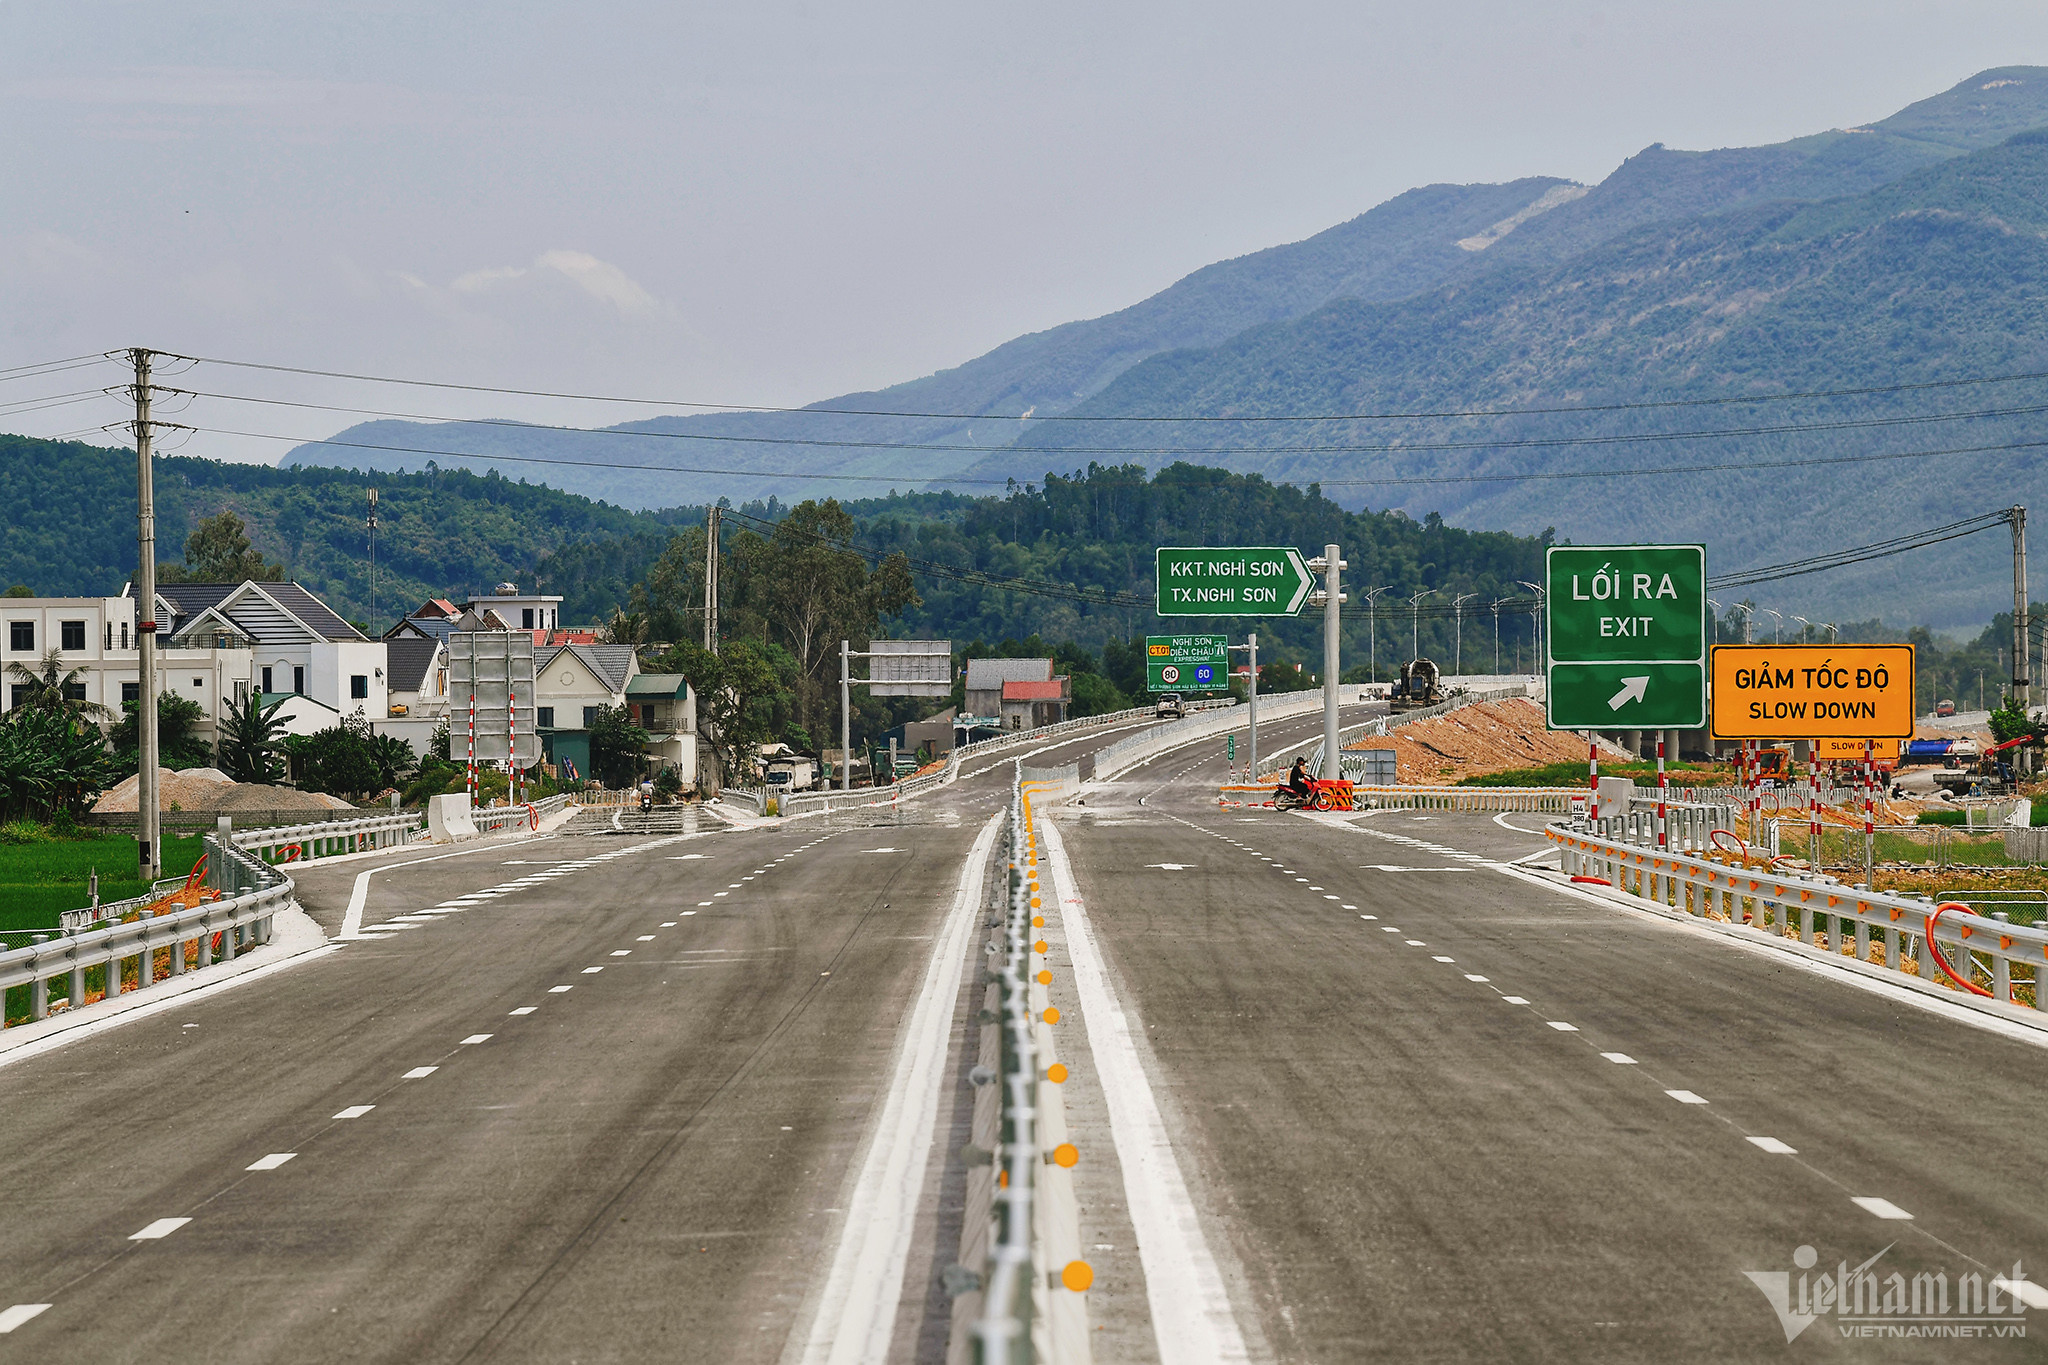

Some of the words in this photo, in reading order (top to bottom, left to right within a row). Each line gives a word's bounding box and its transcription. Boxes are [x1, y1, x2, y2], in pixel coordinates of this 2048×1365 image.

[1250, 560, 1284, 577] SƠN
[1572, 562, 1620, 601] LỐI
[1633, 573, 1678, 600] RA
[1171, 588, 1235, 603] TX.NGHI
[1242, 587, 1276, 603] SƠN
[1600, 617, 1653, 637] EXIT
[1172, 638, 1193, 647] NGHI
[1191, 646, 1214, 656] CHÂU
[1164, 670, 1177, 680] 80
[1198, 669, 1210, 679] 60
[1735, 661, 1794, 689] GIẢM
[1802, 659, 1849, 689] TỐC
[1856, 663, 1889, 693] ĐỘ
[1749, 702, 1807, 720] SLOW
[1814, 702, 1875, 719] DOWN
[1831, 742, 1855, 750] SLOW
